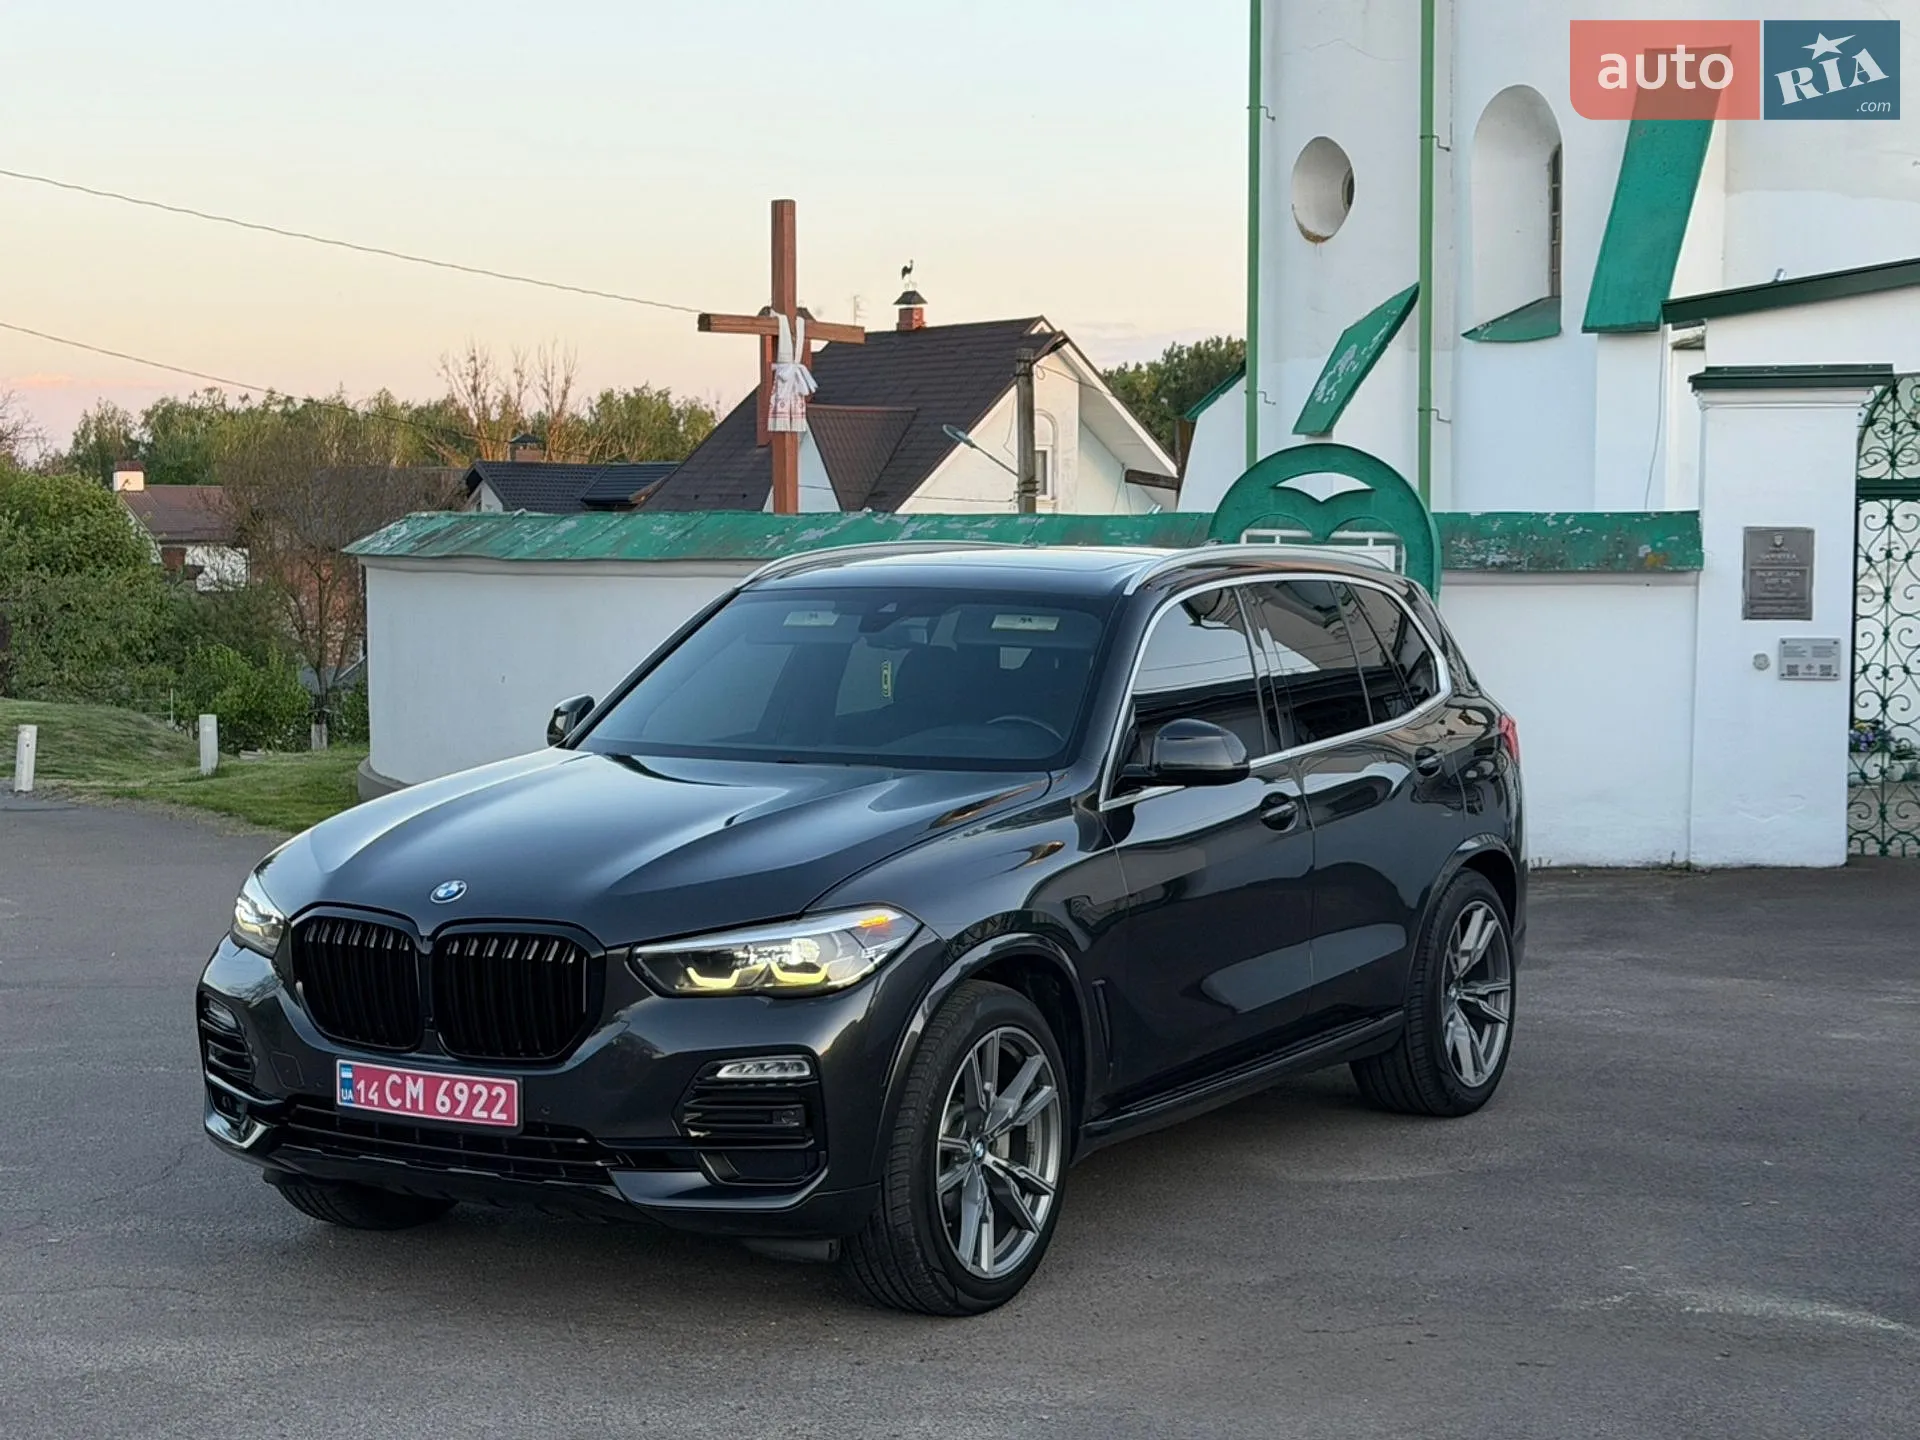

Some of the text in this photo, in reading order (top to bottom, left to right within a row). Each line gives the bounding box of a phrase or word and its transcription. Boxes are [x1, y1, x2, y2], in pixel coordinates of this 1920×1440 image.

[341, 1088, 354, 1101] UA
[356, 1073, 508, 1121] 14 CM 6922
